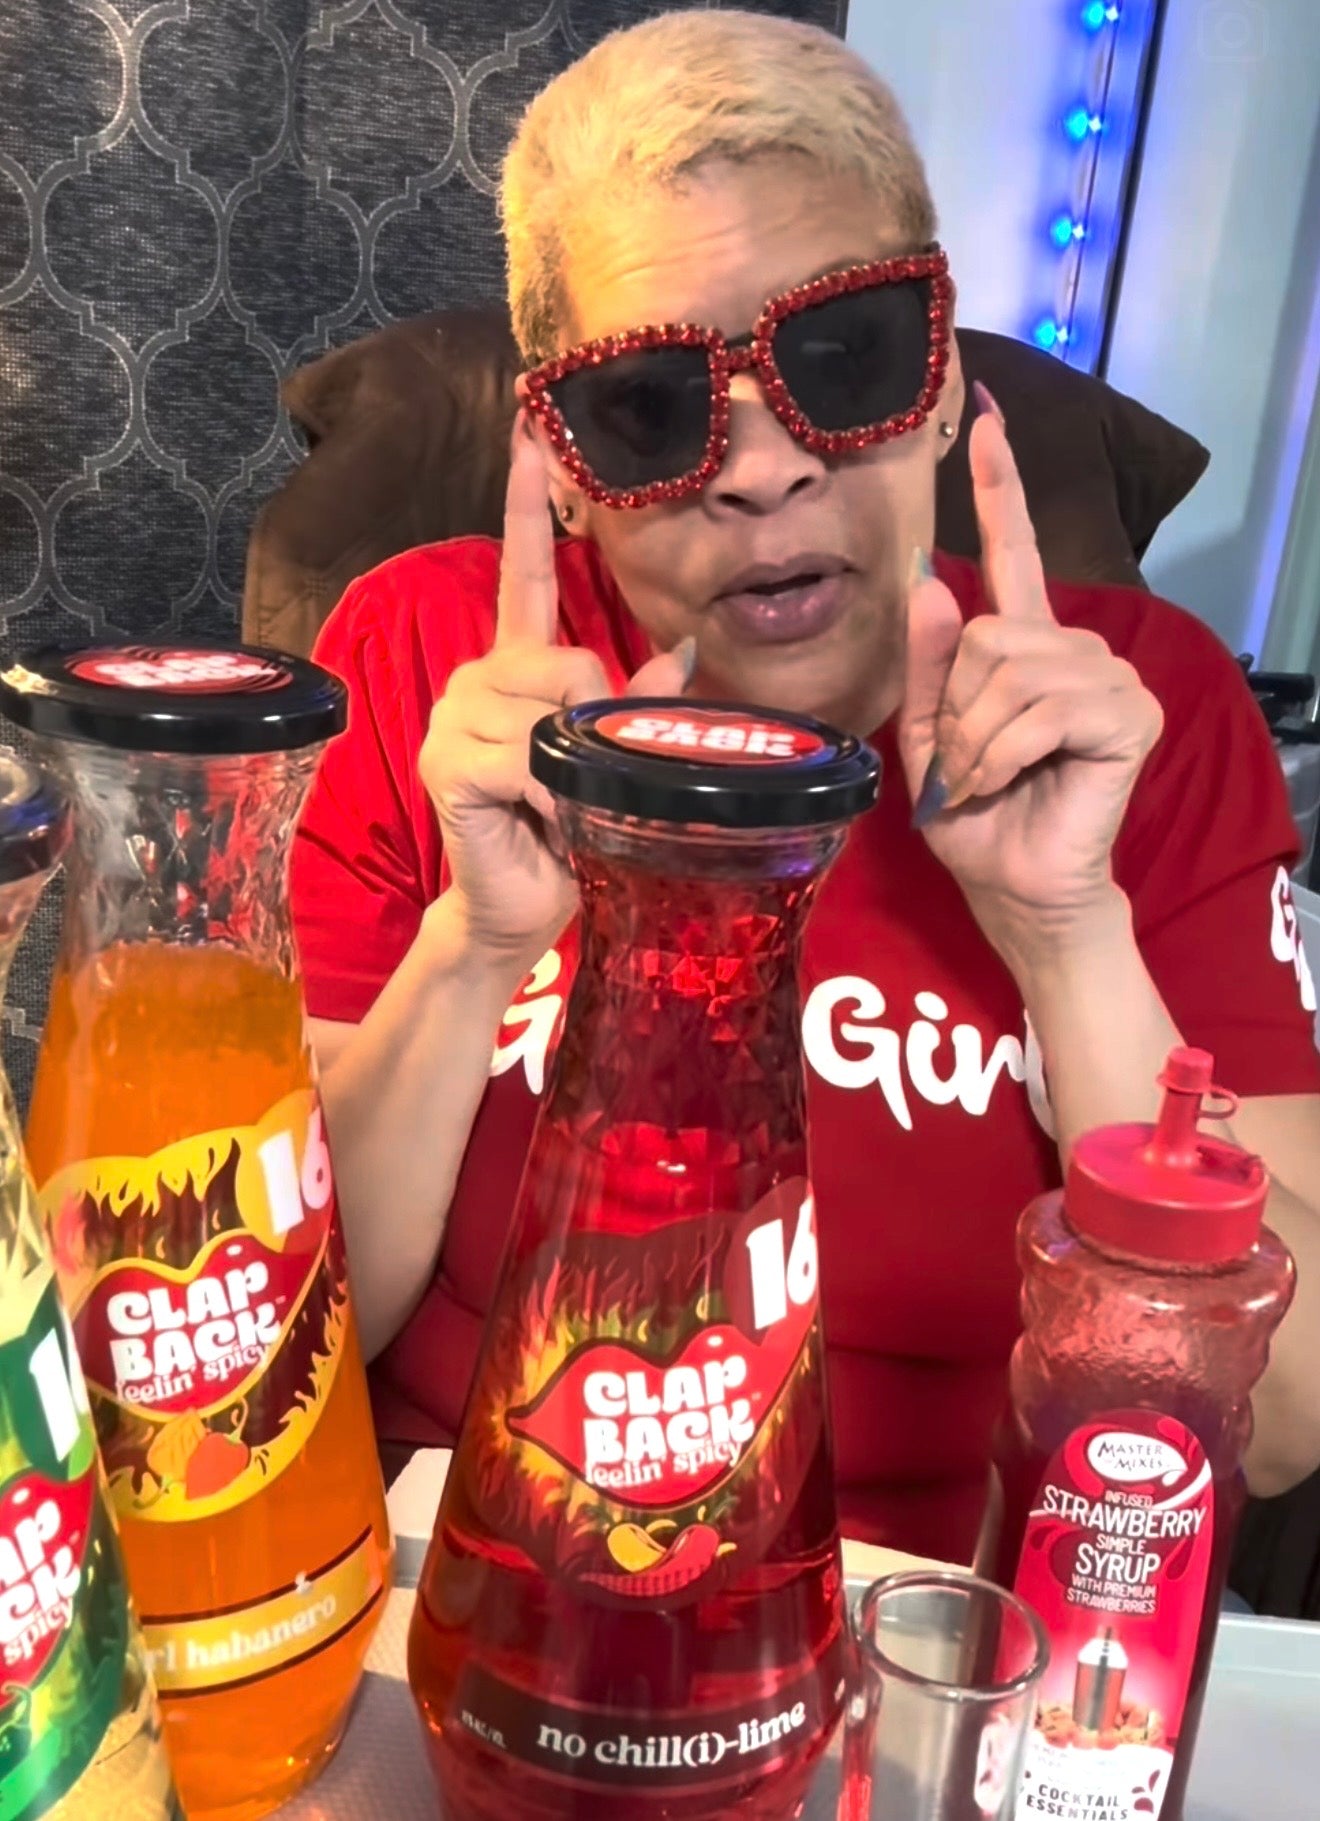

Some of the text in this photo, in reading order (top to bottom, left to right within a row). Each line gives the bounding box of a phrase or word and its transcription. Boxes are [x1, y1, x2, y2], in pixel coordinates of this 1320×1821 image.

[257, 1105, 332, 1236] 16
[746, 1194, 818, 1330] 16
[107, 1262, 269, 1335] CLAP
[110, 1303, 281, 1381] BACK
[204, 1342, 270, 1379] spicy
[583, 1355, 747, 1416] CLAP
[583, 1398, 755, 1466] BACK
[1098, 1441, 1163, 1458] MASTER
[673, 1441, 743, 1475] spicy
[1114, 1457, 1163, 1472] MIXES
[1042, 1485, 1207, 1538] STRAWBERRY
[1105, 1490, 1154, 1509] INFUSED
[1075, 1543, 1161, 1584] SYRUP
[1096, 1534, 1147, 1555] SIMPLE
[1067, 1588, 1156, 1613] STRAWBERRIES
[1072, 1573, 1156, 1598] WITH PREMIUM
[186, 1594, 338, 1669] habanero
[537, 1723, 586, 1758] no
[594, 1701, 806, 1768] chill(i)-lime
[1026, 1794, 1128, 1821] ESSENTIALS
[1038, 1784, 1120, 1807] COCKTAIL
